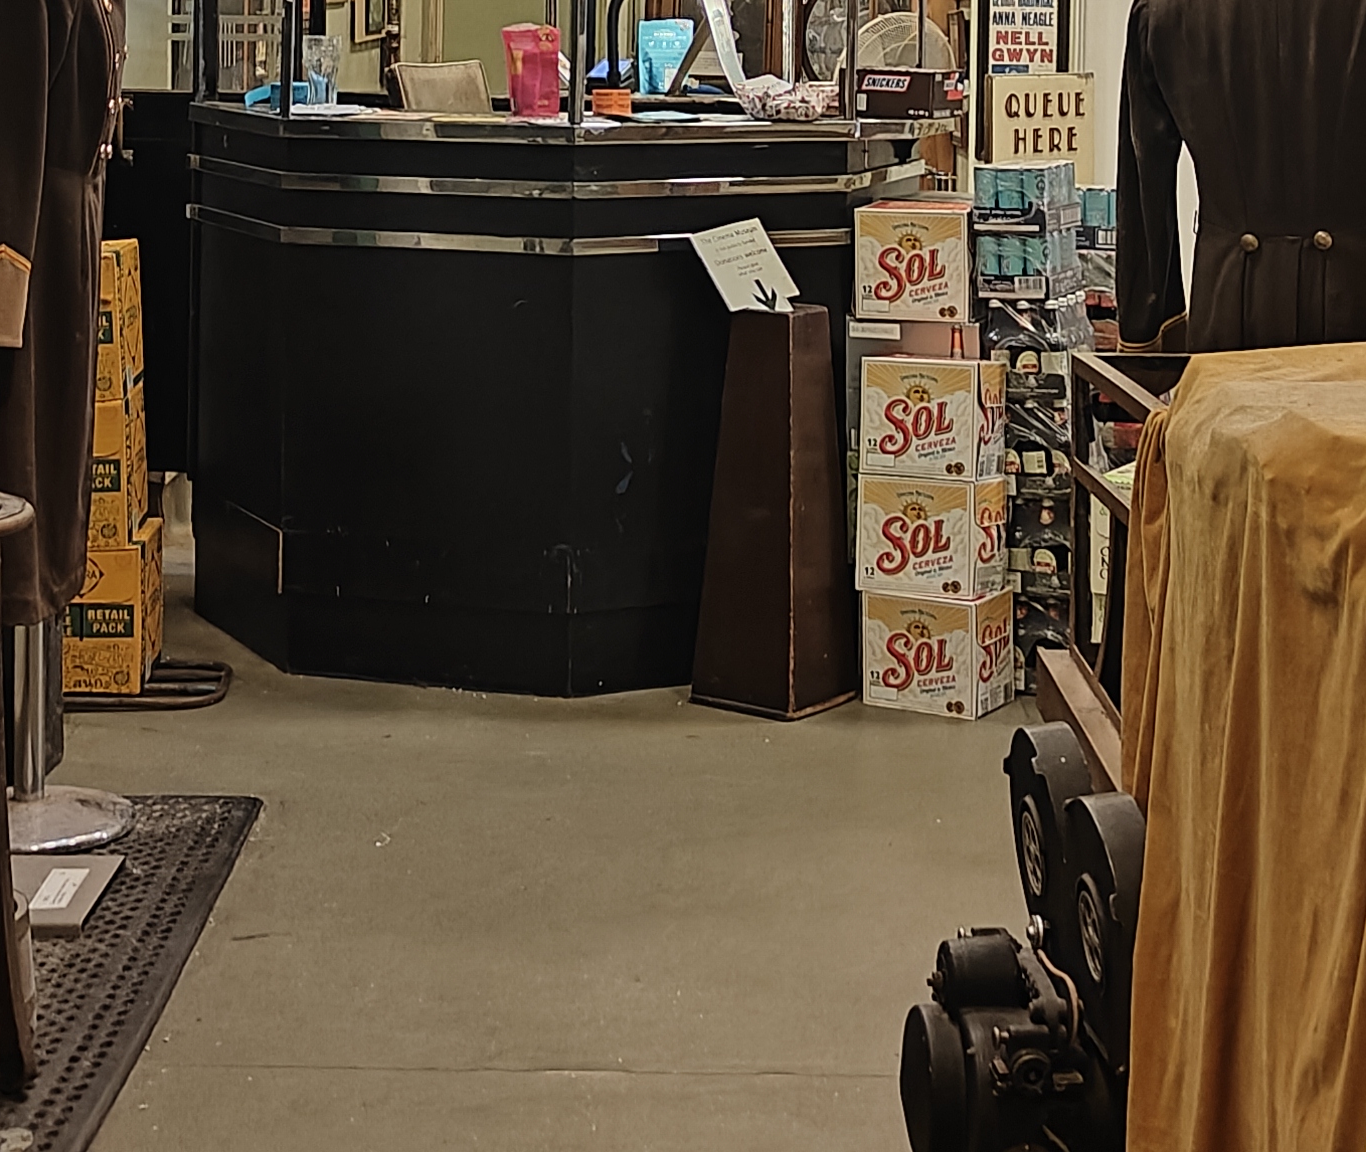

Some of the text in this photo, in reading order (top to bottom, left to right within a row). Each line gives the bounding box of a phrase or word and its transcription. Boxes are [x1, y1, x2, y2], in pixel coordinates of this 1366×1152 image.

[992, 10, 1054, 27] ANNA NEAGLE
[995, 29, 1050, 46] NELL
[991, 48, 1054, 64] GWYN
[865, 76, 908, 90] SNICKERS
[1004, 91, 1086, 119] QUEUE
[1013, 126, 1078, 155] HERE
[873, 246, 947, 305] SOL
[862, 284, 873, 294] 12
[908, 281, 949, 298] CERVEZA
[878, 397, 955, 459] SOL
[867, 437, 878, 447] 12
[914, 436, 957, 453] CERVEZA
[875, 515, 952, 576] SOL
[864, 566, 875, 577] 12
[912, 554, 954, 572] CERVEZA
[87, 608, 131, 622] RETAIL
[92, 621, 125, 635] PACK
[881, 632, 955, 692] SOL
[869, 670, 881, 681] 12
[916, 674, 957, 689] CERVEZA
